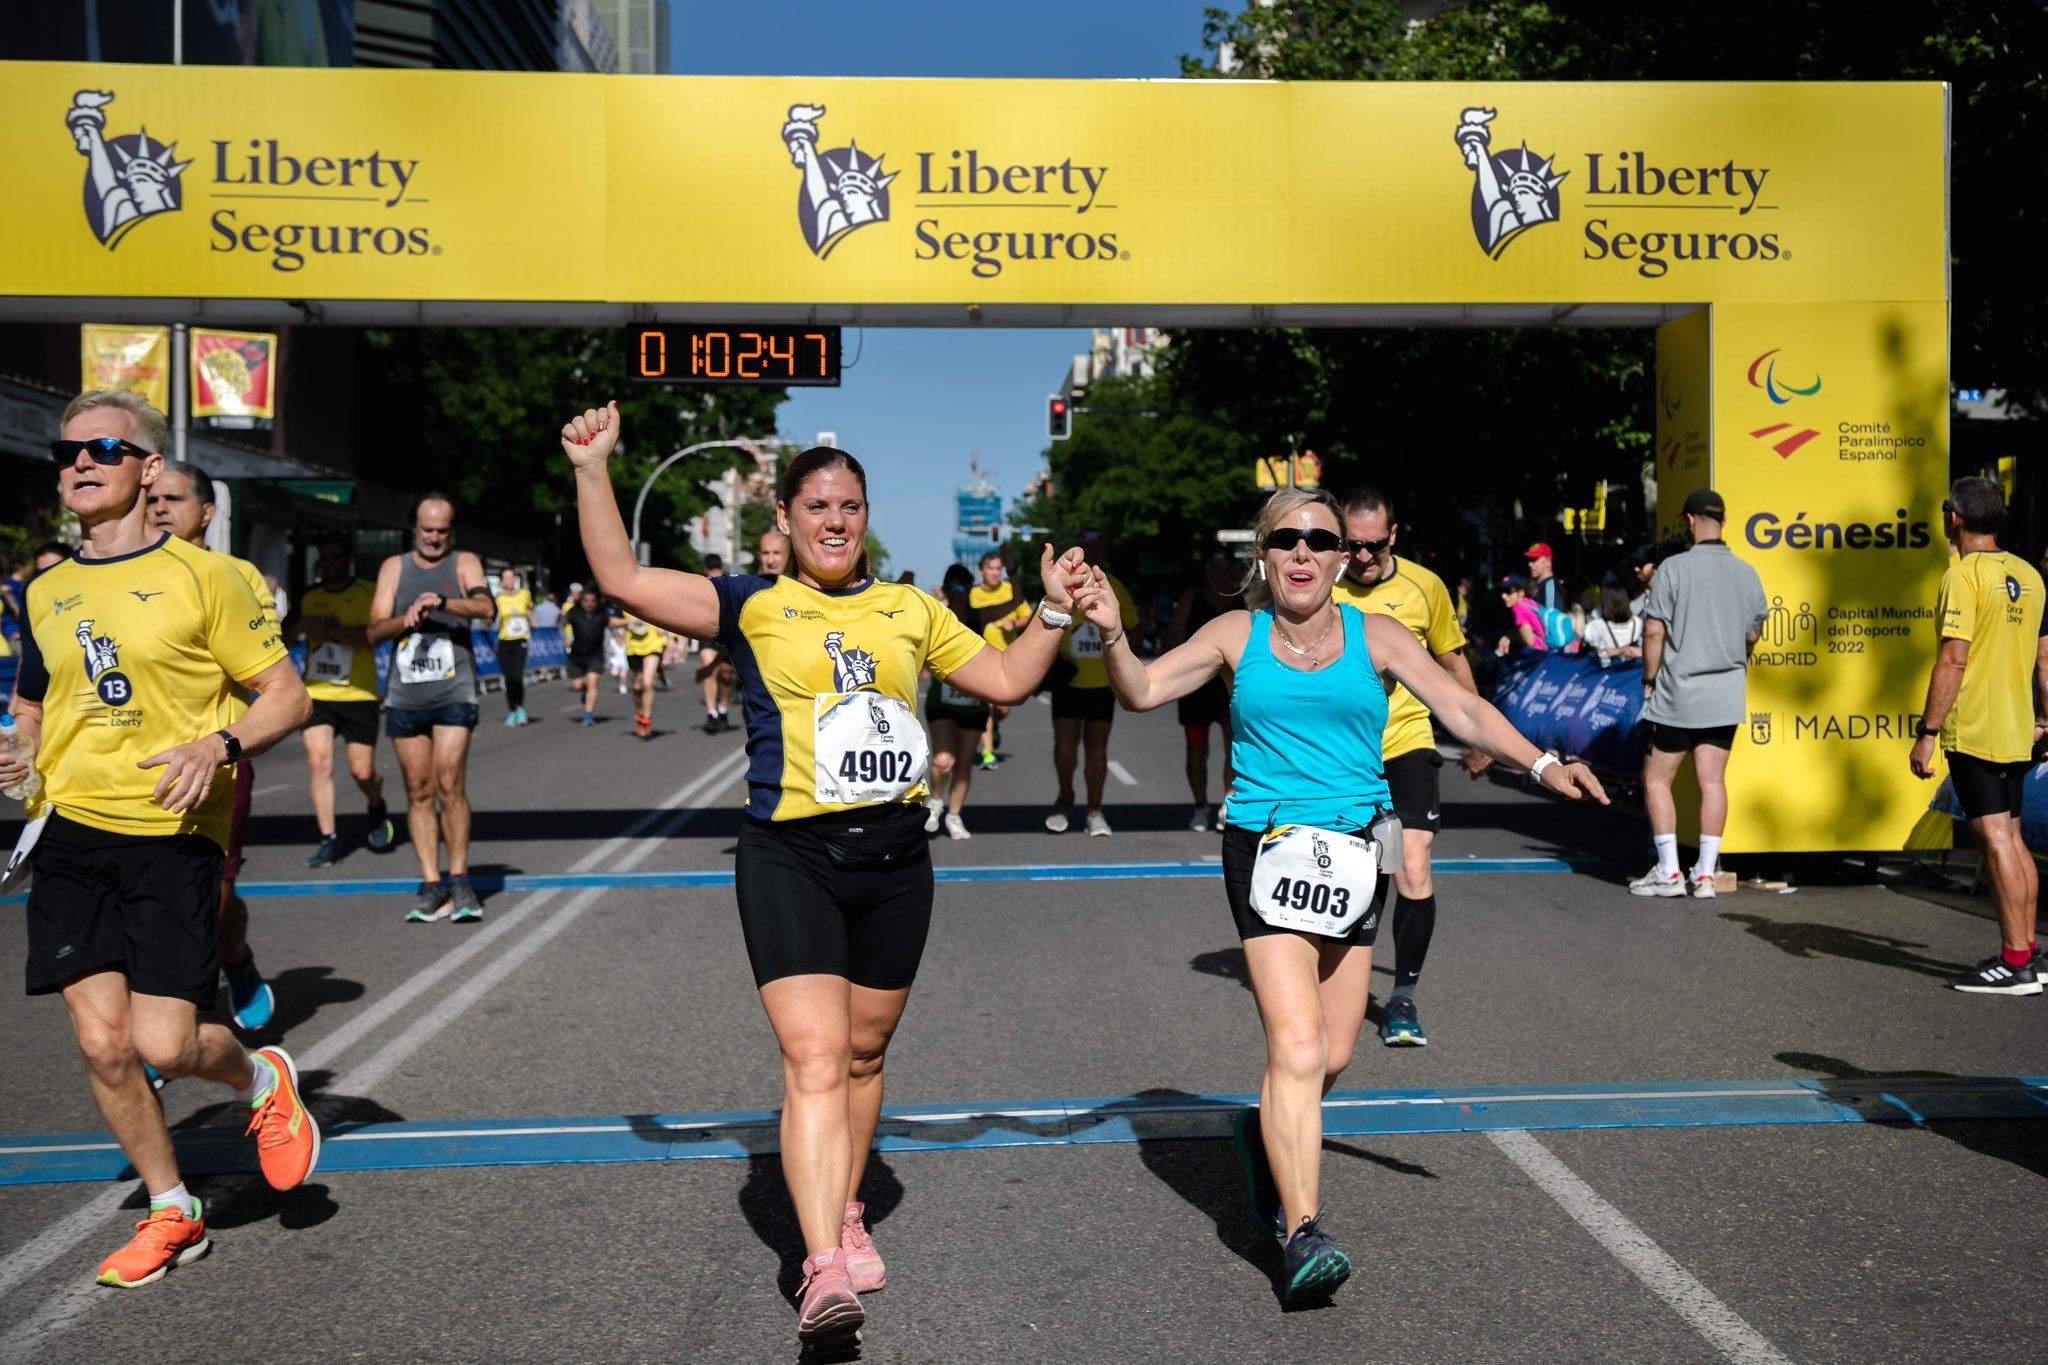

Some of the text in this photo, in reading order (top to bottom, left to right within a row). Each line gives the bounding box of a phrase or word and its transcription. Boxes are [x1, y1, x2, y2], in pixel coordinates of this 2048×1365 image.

[211, 139, 420, 208] Liberty
[916, 149, 1110, 214] Liberty
[1584, 151, 1771, 215] Liberty
[1838, 421, 1891, 434] Comité
[1838, 435, 1926, 450] Paralímpico
[1839, 449, 1897, 463] Español
[1745, 508, 1931, 550] Génesis
[1827, 607, 1937, 621] Capital Mundial
[1827, 625, 1911, 638] del Deporte
[1827, 641, 1865, 654] 2022
[103, 679, 127, 699] 13
[111, 718, 142, 728] Liberty
[839, 750, 913, 783] 4902
[1271, 876, 1351, 918] 4903
